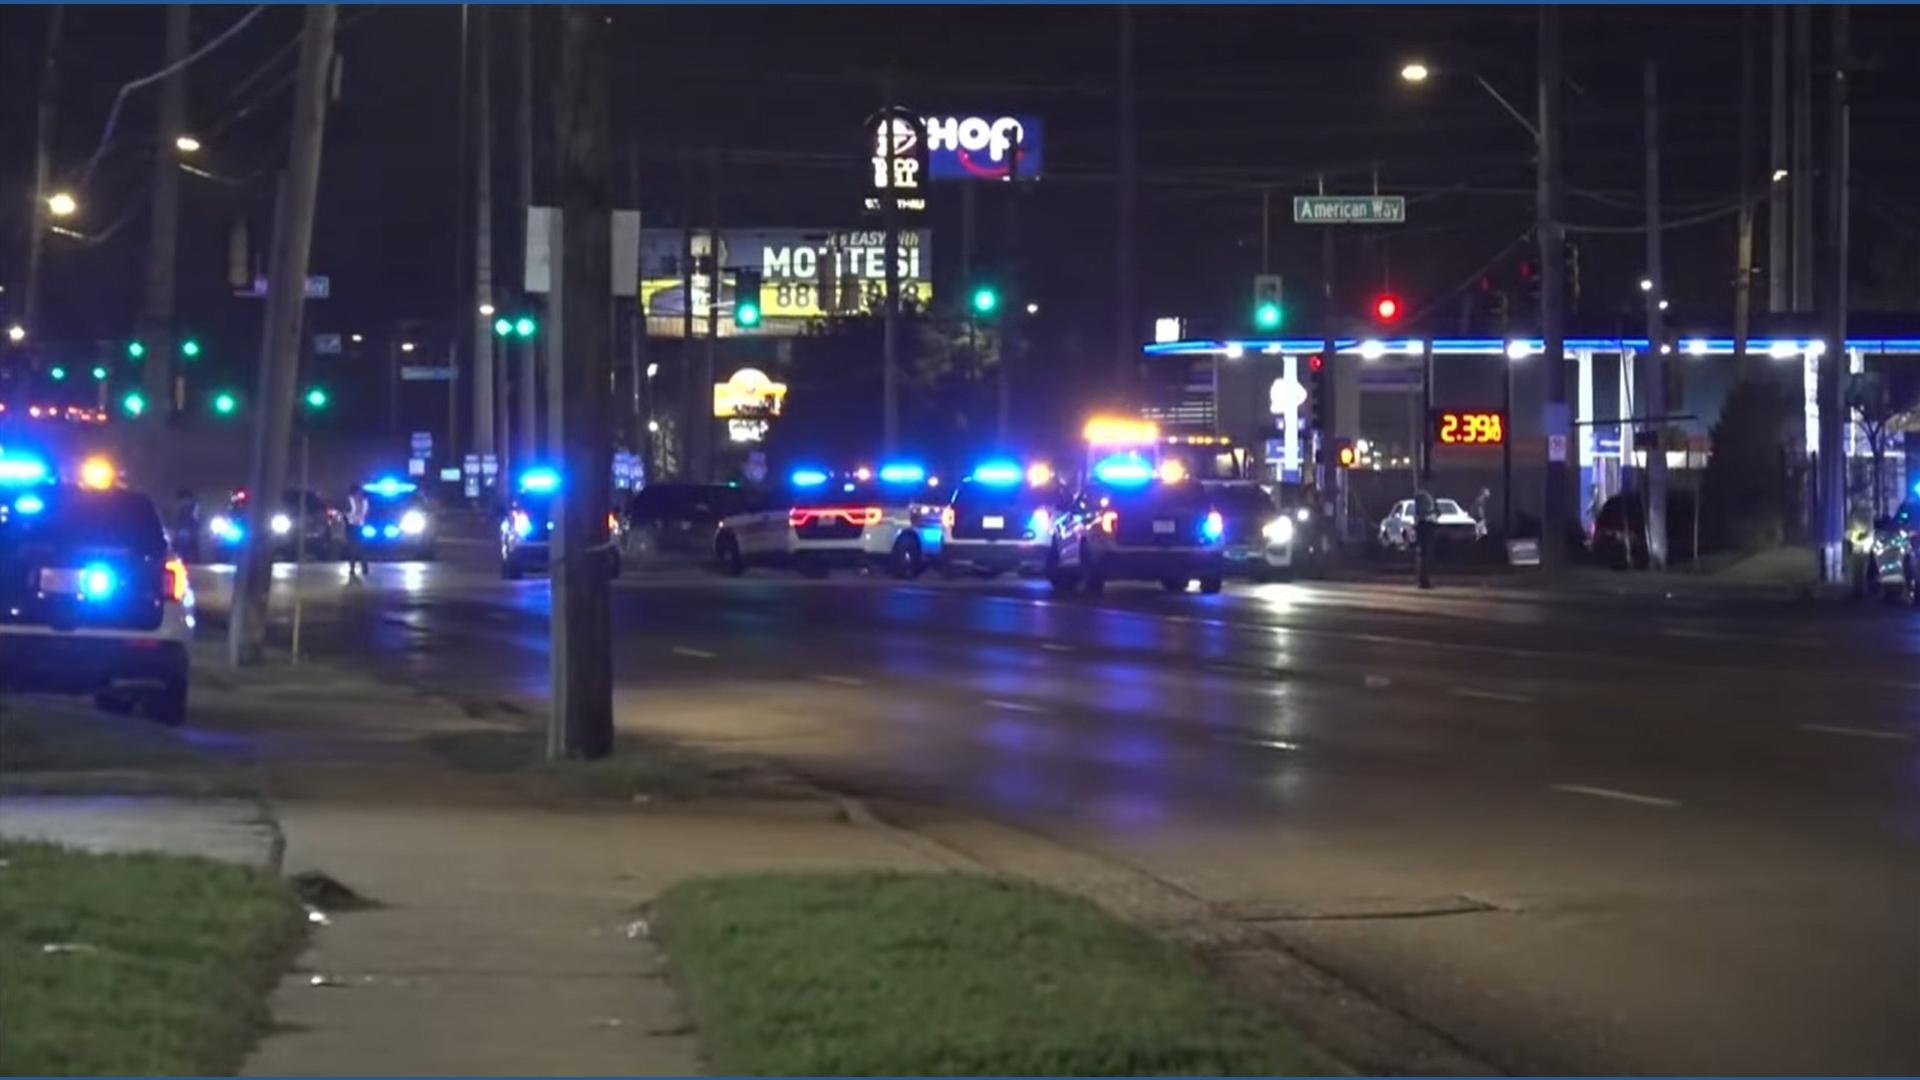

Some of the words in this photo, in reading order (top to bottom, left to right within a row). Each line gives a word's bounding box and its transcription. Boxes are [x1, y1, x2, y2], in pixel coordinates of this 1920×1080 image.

[920, 117, 1024, 162] HOP
[1301, 200, 1367, 218] American
[1372, 199, 1399, 220] Way
[850, 231, 887, 245] EASY
